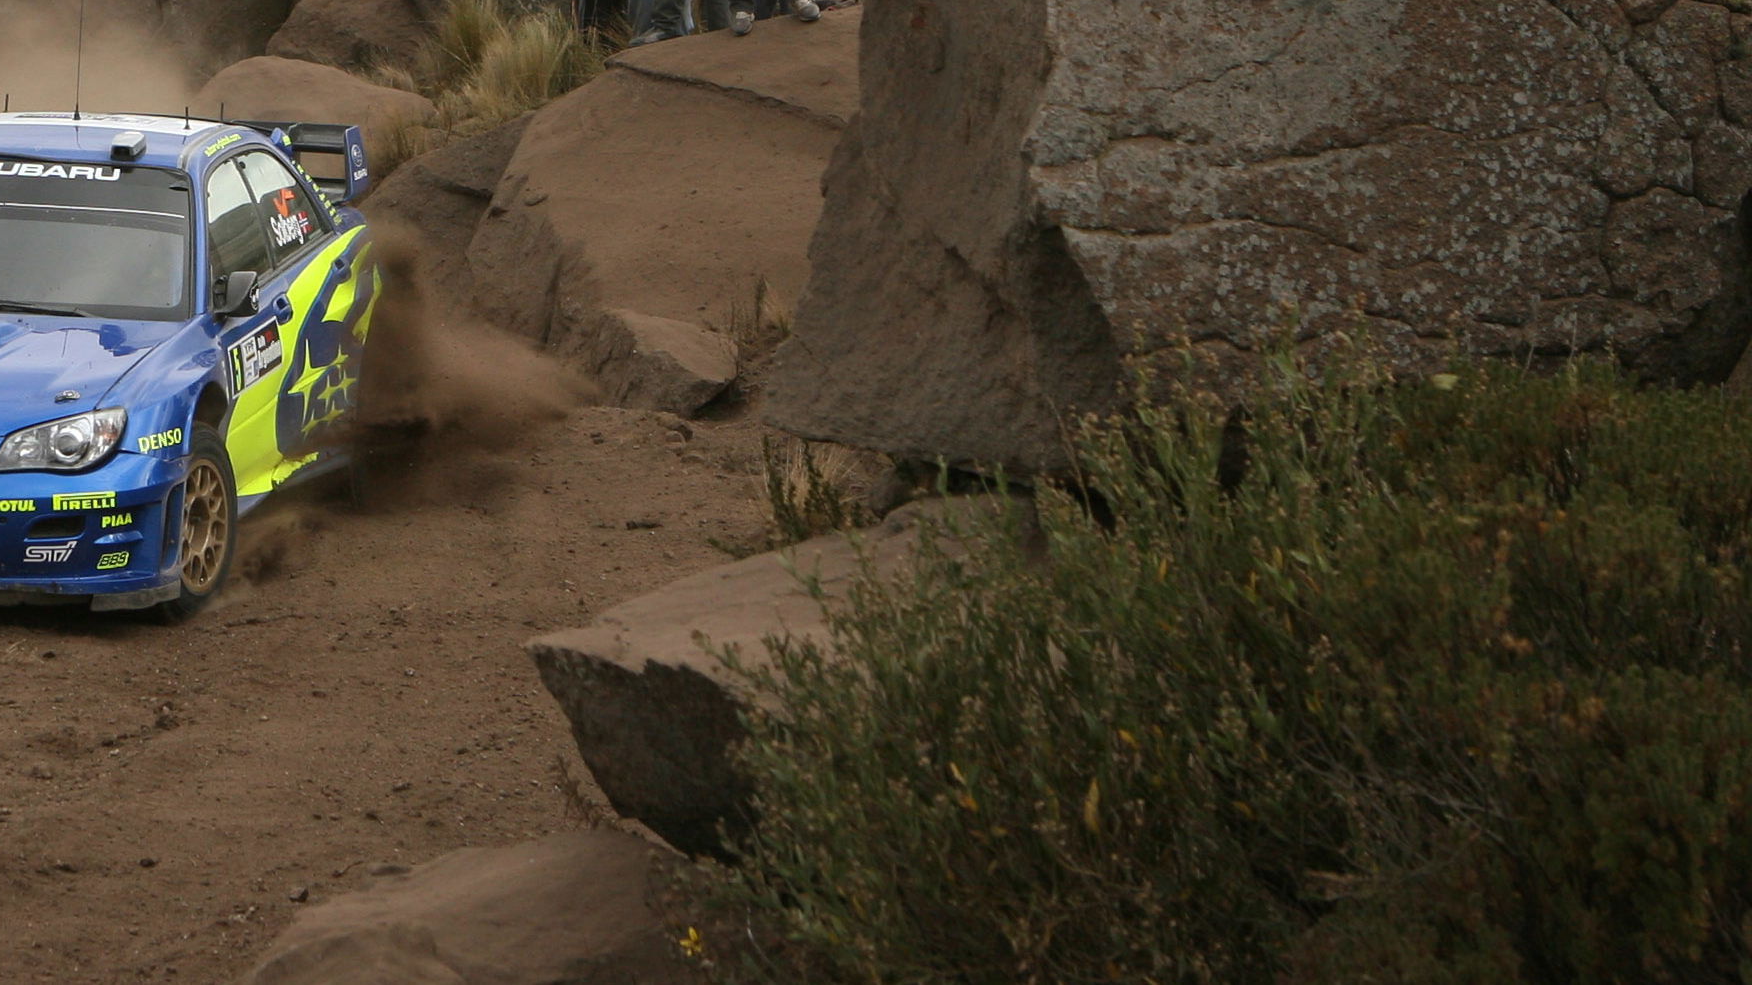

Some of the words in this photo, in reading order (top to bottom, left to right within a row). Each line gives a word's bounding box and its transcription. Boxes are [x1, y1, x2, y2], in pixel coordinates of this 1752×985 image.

[138, 427, 182, 453] DENSO
[52, 491, 116, 511] PIRELLI
[101, 512, 133, 529] PIAA
